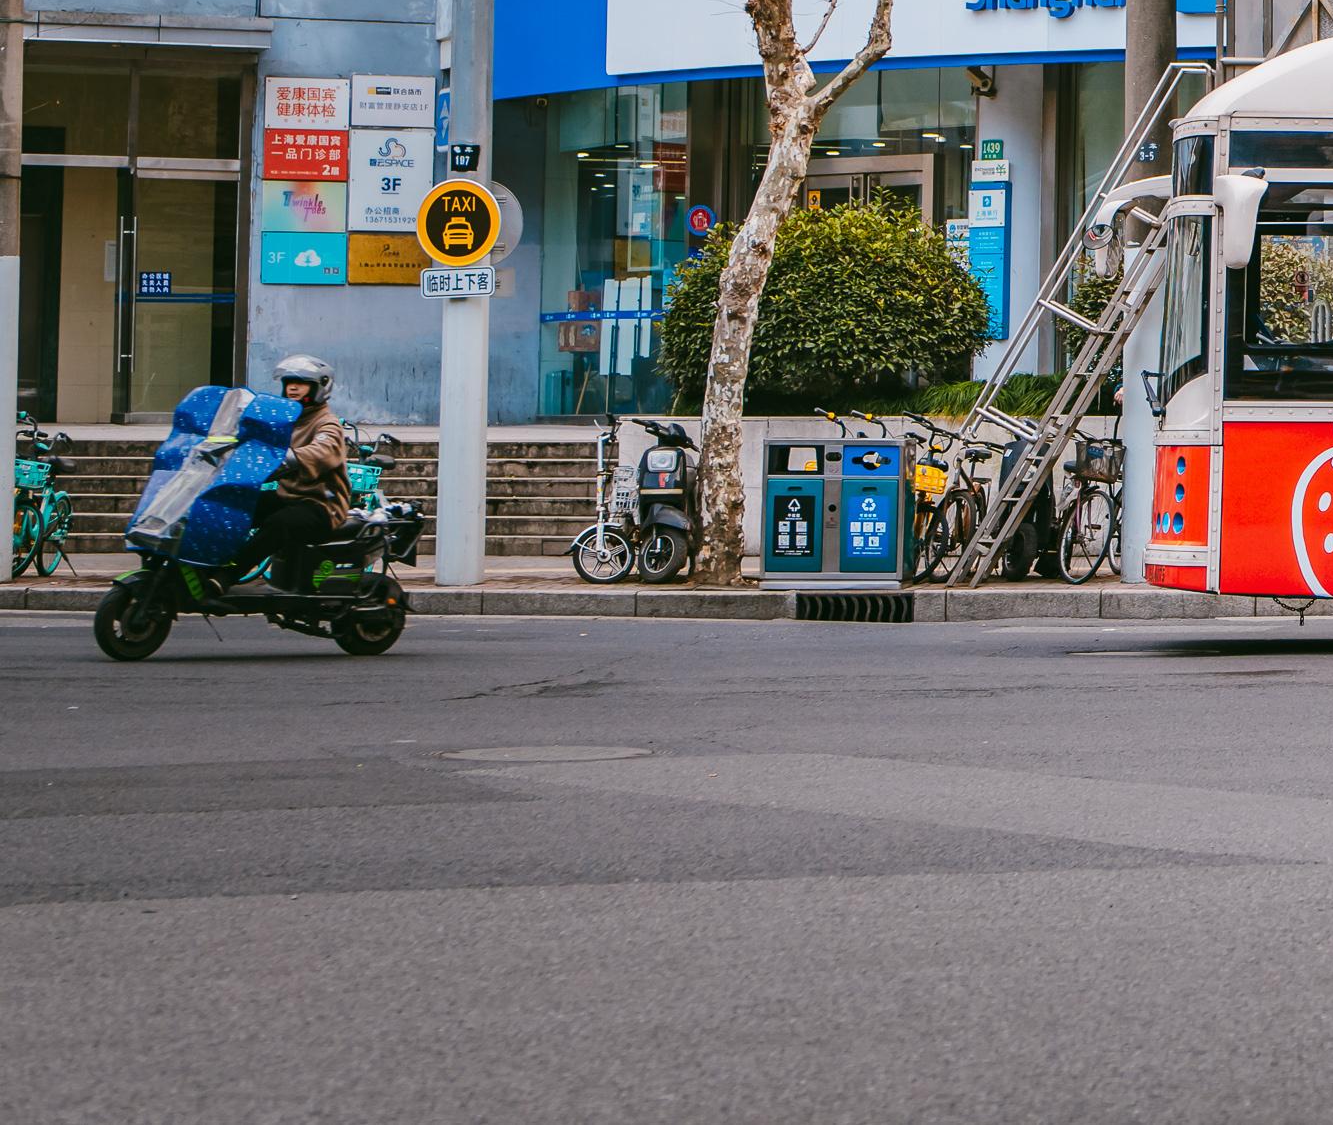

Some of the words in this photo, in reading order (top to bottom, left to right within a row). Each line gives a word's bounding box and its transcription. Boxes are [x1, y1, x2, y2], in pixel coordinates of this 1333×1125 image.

[277, 86, 336, 102] 爱康国宾
[276, 103, 336, 117] 健康体检
[271, 147, 341, 161] 一品门诊部
[983, 142, 1001, 154] 1439
[381, 177, 402, 192] 3F
[442, 196, 476, 212] TAXI
[267, 251, 287, 264] 3F
[427, 272, 489, 293] 临时上下客
